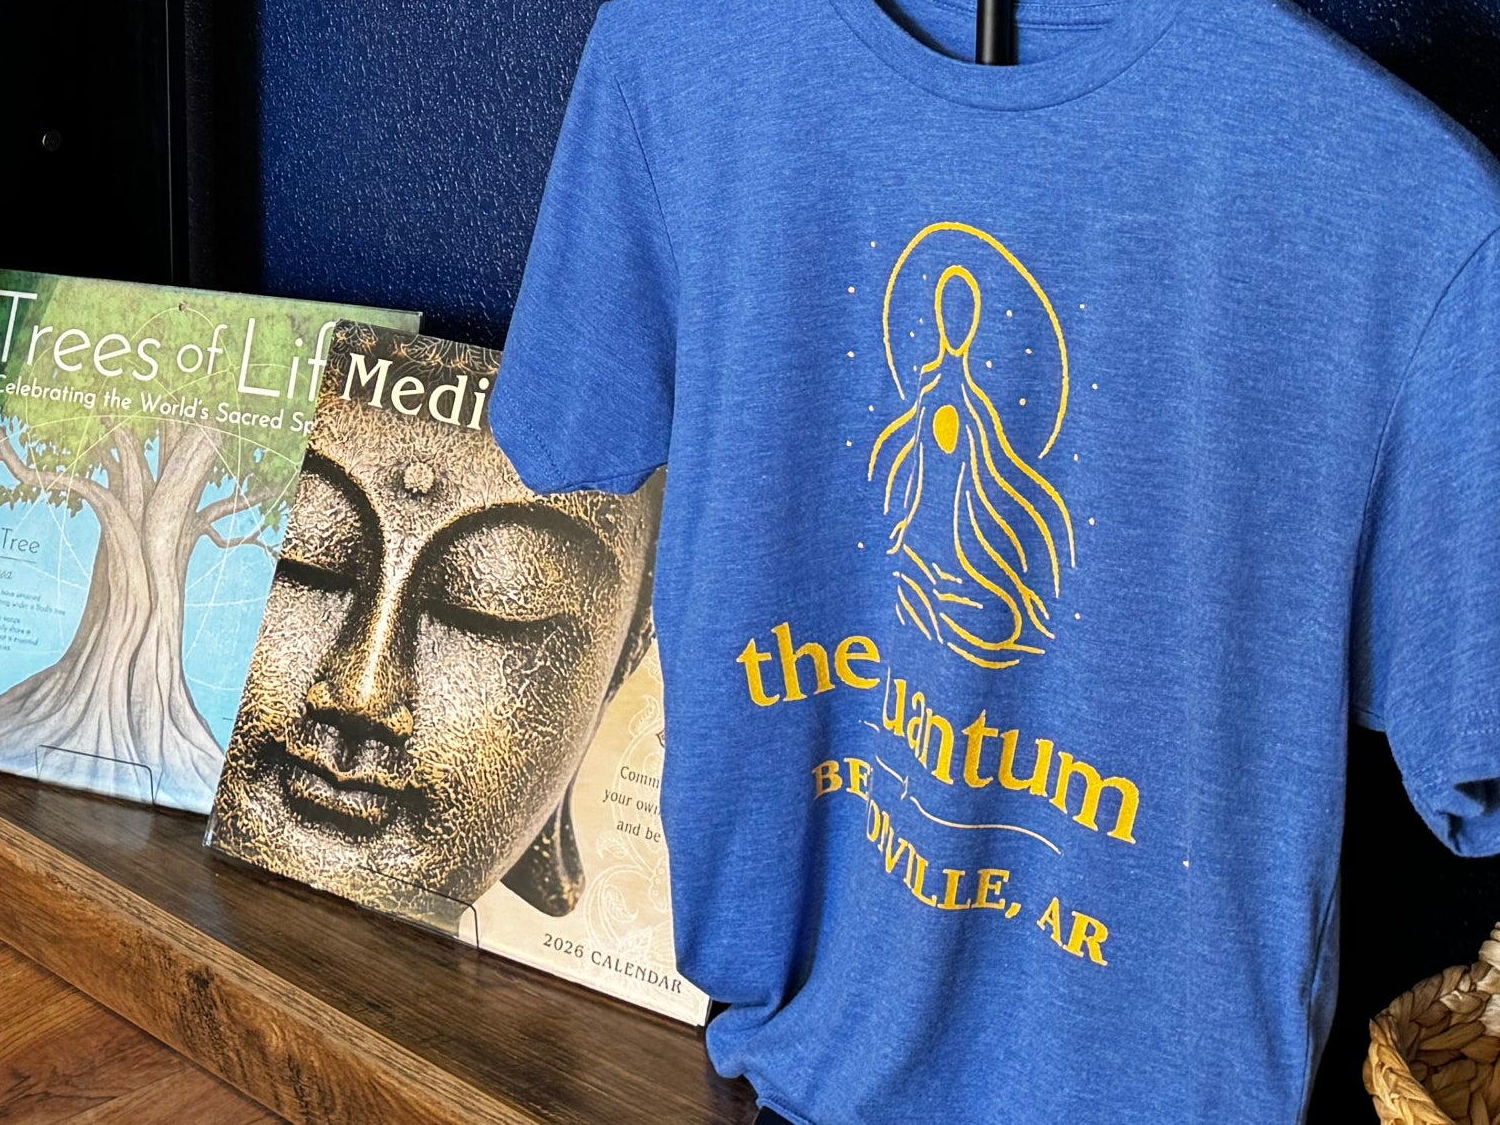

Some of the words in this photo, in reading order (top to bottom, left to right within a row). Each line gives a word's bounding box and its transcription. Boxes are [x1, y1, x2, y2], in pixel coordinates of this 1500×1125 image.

[176, 323, 228, 375] of
[238, 317, 336, 402] Lif
[103, 387, 132, 409] the
[140, 392, 209, 420] World's
[215, 401, 285, 429] Sacred
[340, 352, 490, 431] Medi
[0, 527, 41, 554] Tree
[735, 622, 881, 707] the
[619, 765, 660, 790] Comm
[881, 667, 1142, 845] uantum
[602, 788, 633, 807] your
[616, 819, 642, 838] and
[1036, 896, 1109, 967] AR
[542, 932, 585, 959] 2026
[590, 949, 683, 995] CALENDAR
